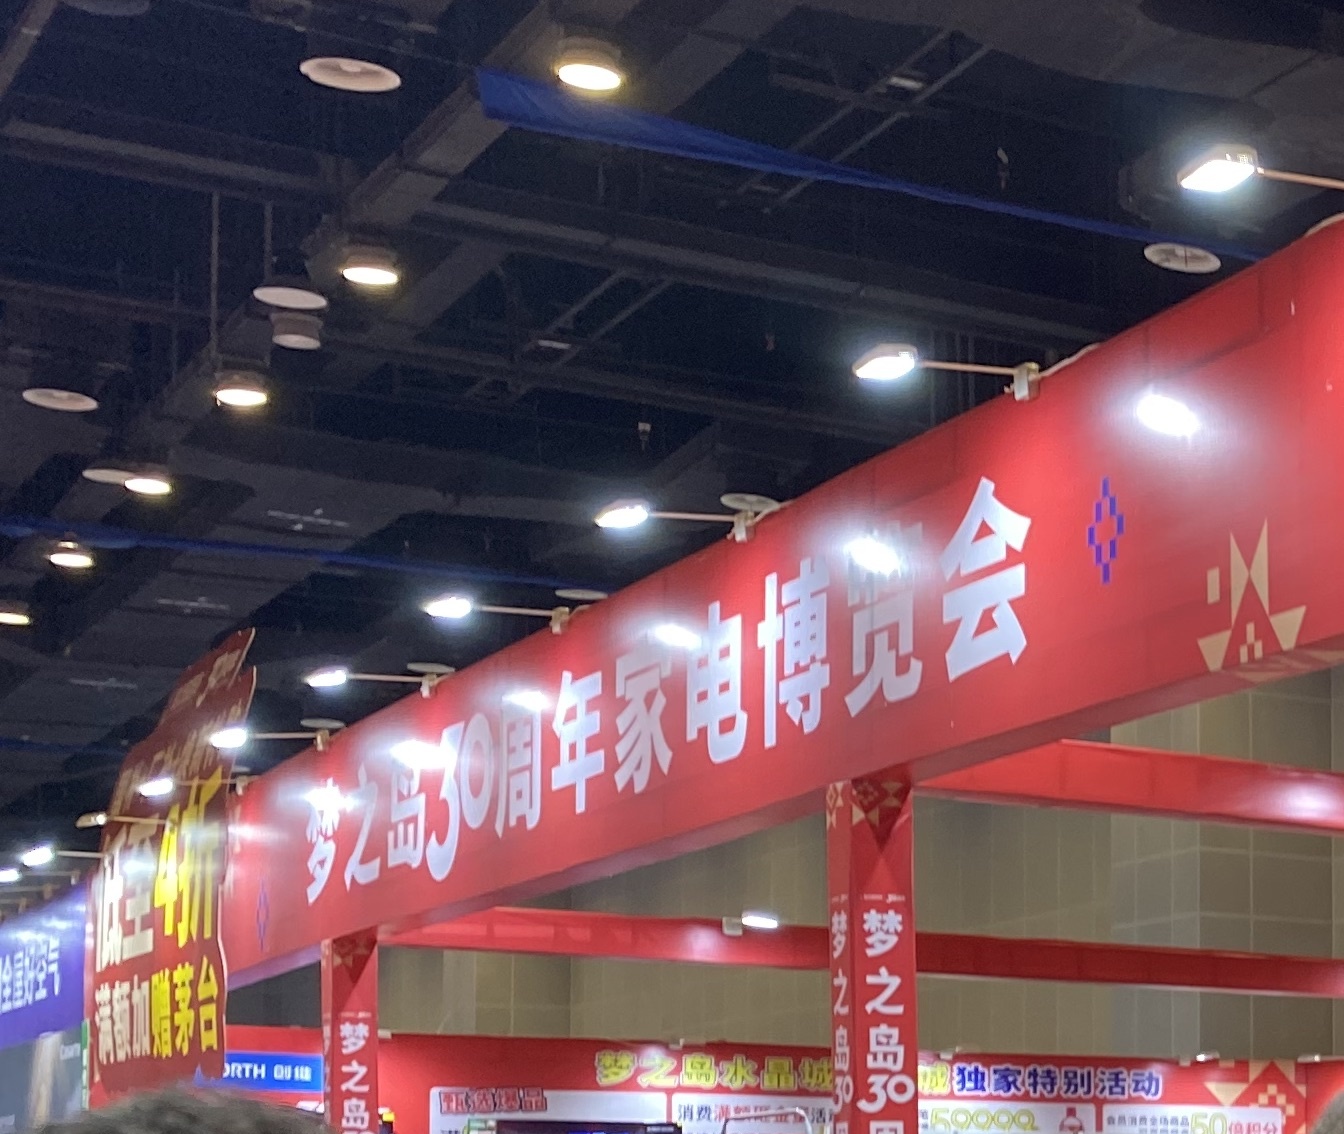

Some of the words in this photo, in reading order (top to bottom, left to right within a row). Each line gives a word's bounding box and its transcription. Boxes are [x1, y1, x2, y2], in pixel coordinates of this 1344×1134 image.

[304, 475, 1031, 907] 梦之岛30周年家电博览会
[97, 766, 222, 974] 低至4折
[93, 956, 220, 1066] 满额加赠茅台
